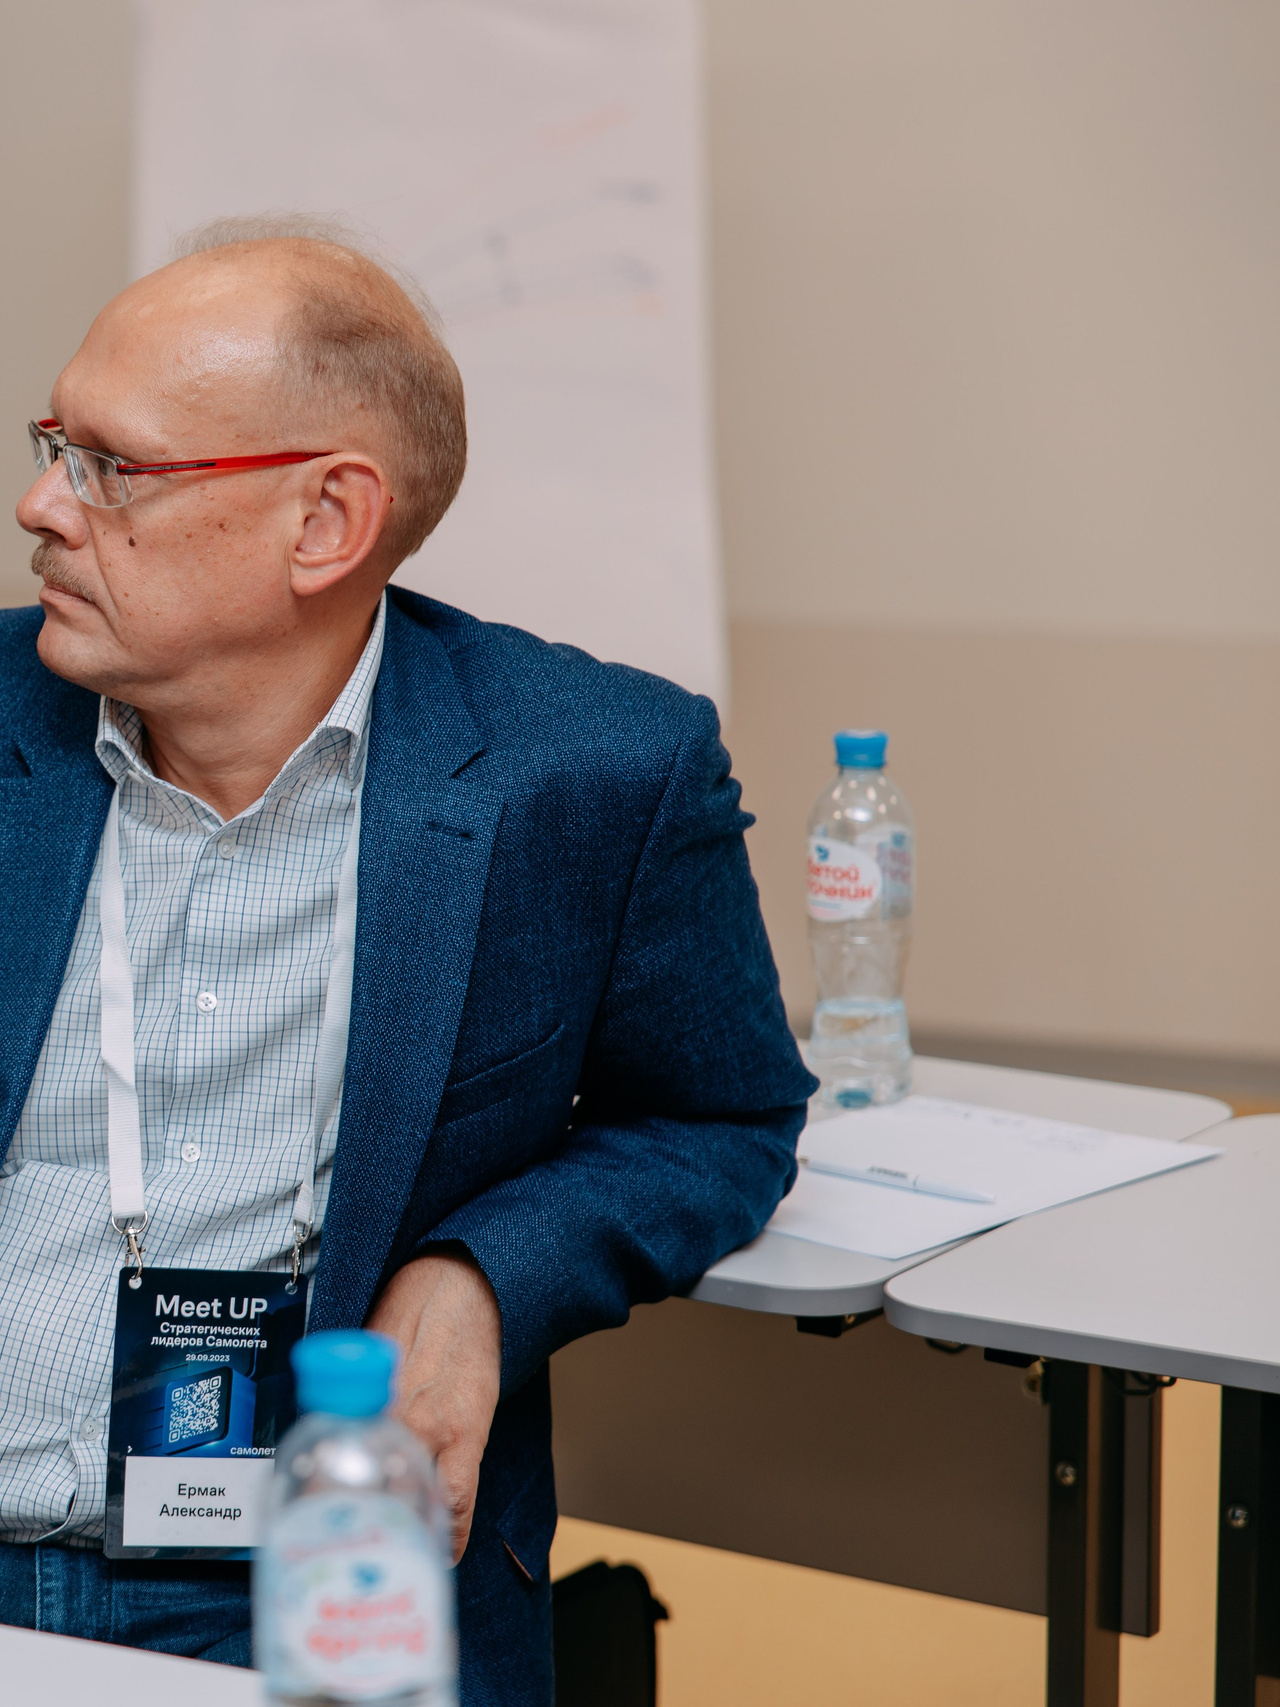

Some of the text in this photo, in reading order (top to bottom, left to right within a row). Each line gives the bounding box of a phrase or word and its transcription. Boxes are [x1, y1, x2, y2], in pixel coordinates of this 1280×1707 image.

[155, 1294, 268, 1319] Meet UP
[160, 1322, 261, 1336] Стратегических
[150, 1335, 268, 1349] лидеров Самолета
[185, 1354, 230, 1362] 29.09.2023
[230, 1446, 277, 1456] самолет
[177, 1483, 226, 1499] Ермак
[159, 1504, 242, 1520] Александр
